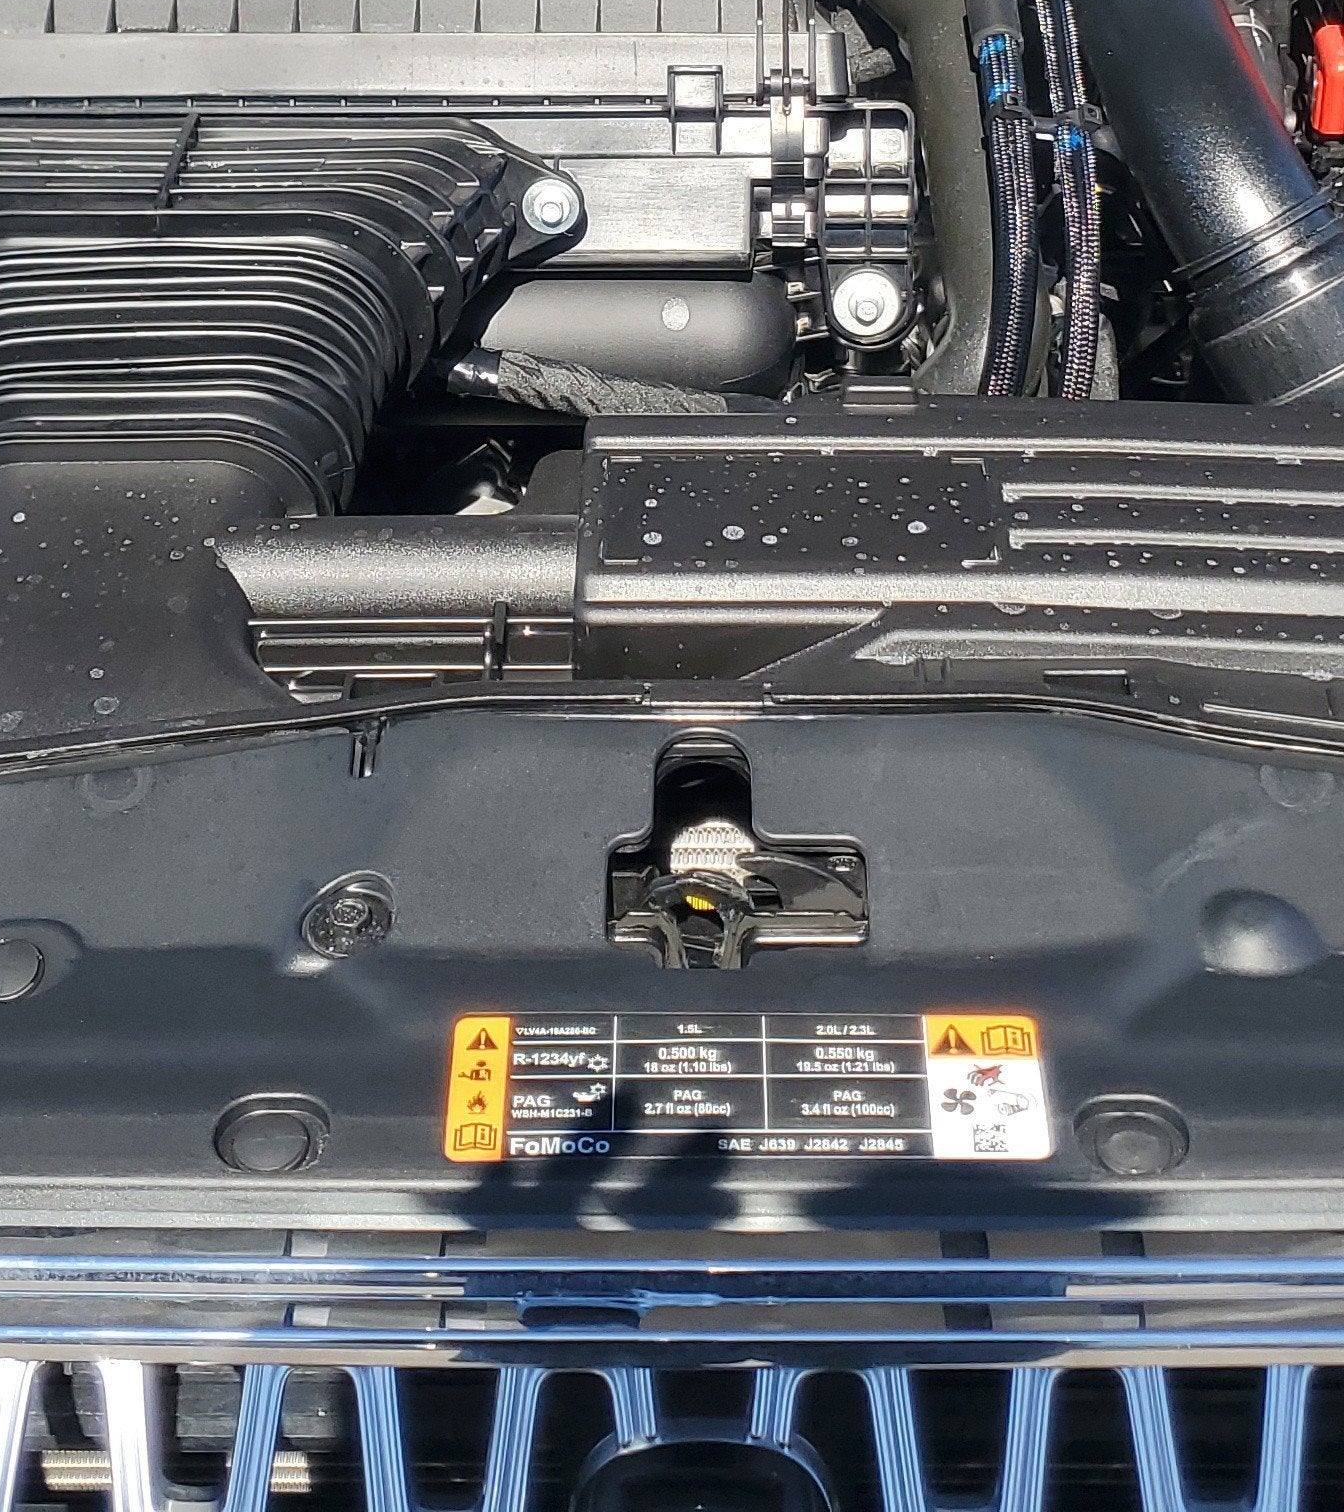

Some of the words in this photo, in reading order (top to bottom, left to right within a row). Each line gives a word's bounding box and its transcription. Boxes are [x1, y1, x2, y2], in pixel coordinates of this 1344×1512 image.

[677, 1024, 703, 1034] 1.5L
[815, 1025, 842, 1035] 2.0L
[849, 1025, 875, 1035] 2.3L
[513, 1052, 586, 1068] R-1234yf
[658, 1047, 696, 1060] 0.500
[699, 1046, 717, 1062] kg
[815, 1047, 853, 1060] 0.550
[856, 1046, 875, 1062] kg
[661, 1064, 676, 1073] oz
[678, 1061, 707, 1074] (1.10
[709, 1061, 732, 1074] lbs)
[824, 1063, 839, 1072] oz
[841, 1061, 869, 1074] (1.21
[872, 1061, 895, 1074] lbs)
[513, 1095, 552, 1108] PAG
[673, 1089, 703, 1101] PAG
[833, 1090, 862, 1101] PAG
[644, 1102, 663, 1115] 2.7
[676, 1105, 692, 1115] oz
[801, 1103, 820, 1115] 3.4
[833, 1106, 849, 1115] oz
[851, 1103, 895, 1117] (100cc)
[509, 1136, 610, 1156] FoMoCo
[717, 1138, 752, 1151] SAE
